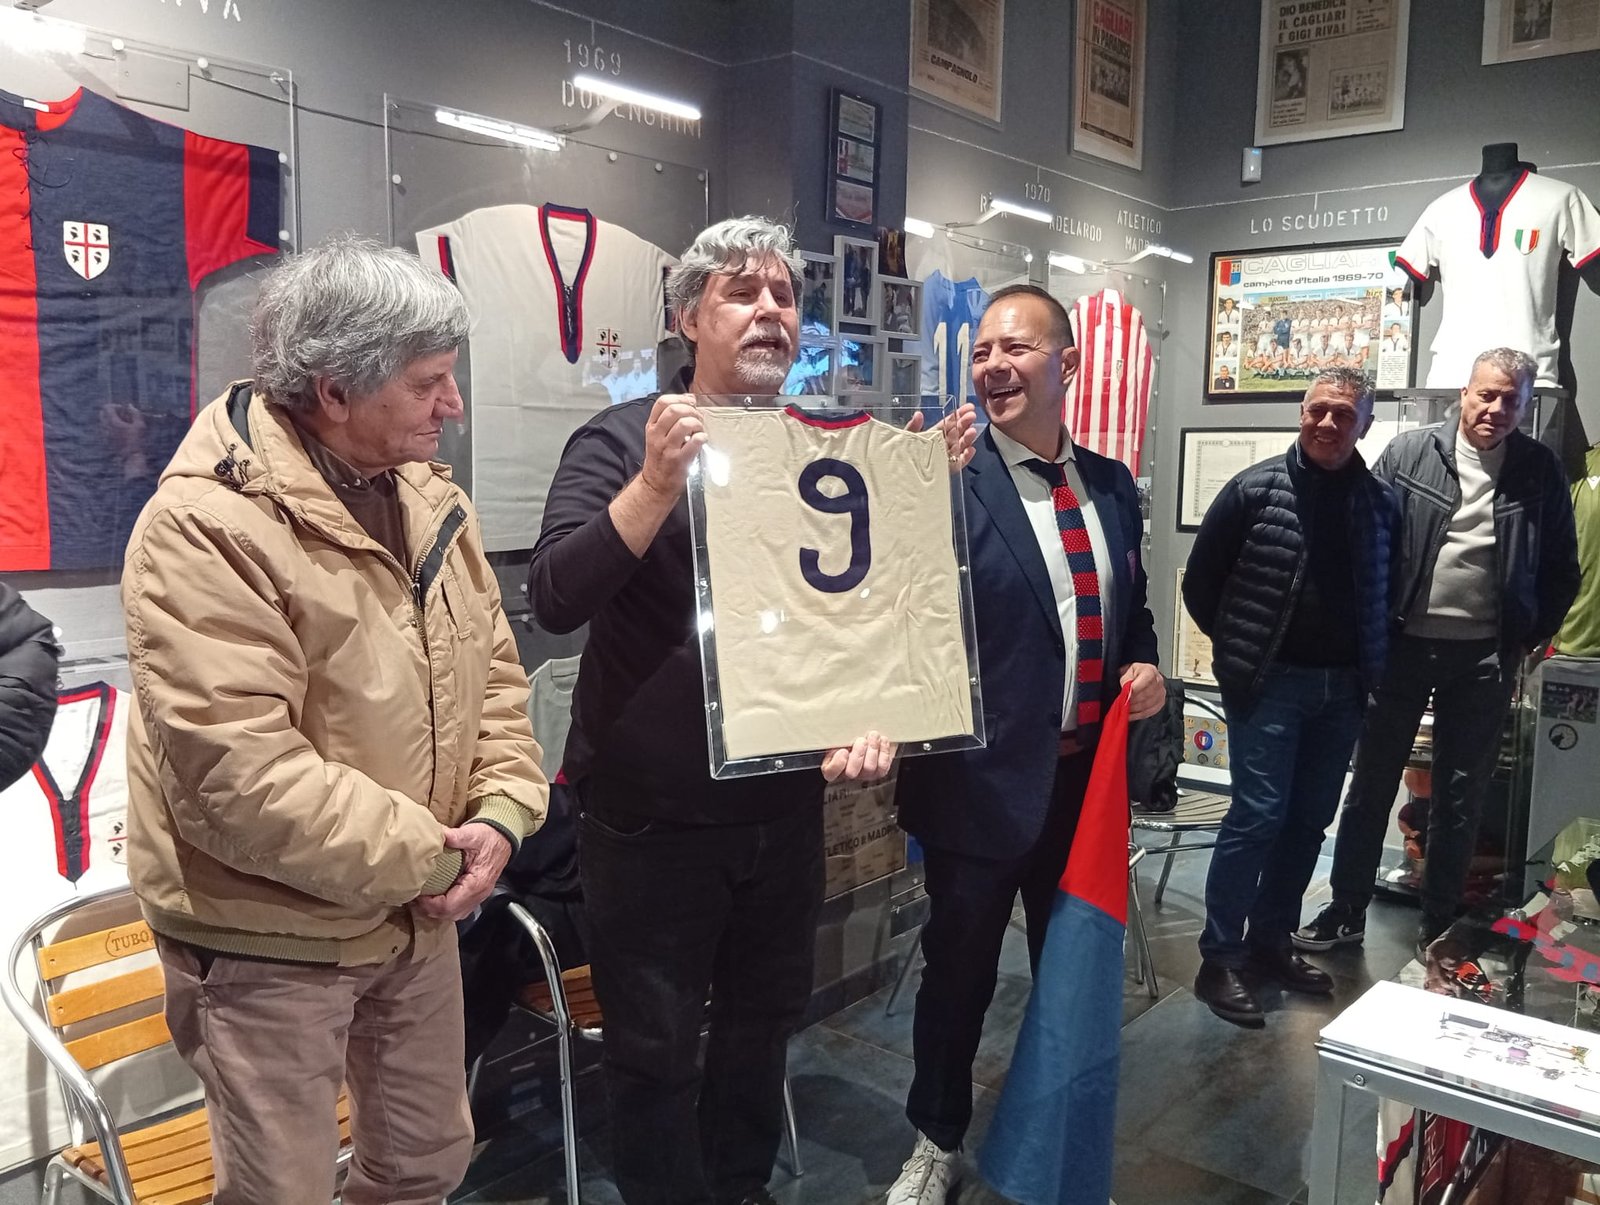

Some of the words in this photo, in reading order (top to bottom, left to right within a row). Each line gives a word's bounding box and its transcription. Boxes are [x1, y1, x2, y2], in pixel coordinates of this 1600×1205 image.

[1280, 5, 1296, 17] DIO
[1299, 0, 1347, 13] BENEDICA
[1293, 9, 1346, 27] CAGLIARI
[1278, 33, 1283, 43] E
[1288, 29, 1311, 42] GIGI
[1315, 23, 1346, 37] RIVA!
[563, 39, 621, 76] 1969
[561, 80, 701, 139] DOENGHINI
[1024, 183, 1051, 203] 1970
[1049, 215, 1102, 242] ADELARDO
[1117, 210, 1161, 235] ATLETICO
[1250, 218, 1272, 234] LO
[1282, 206, 1389, 232] SCUDETTO
[1294, 275, 1331, 285] d'Italia
[1332, 271, 1385, 282] 1969-70
[797, 457, 872, 594] 9
[111, 930, 152, 952] TUBO
